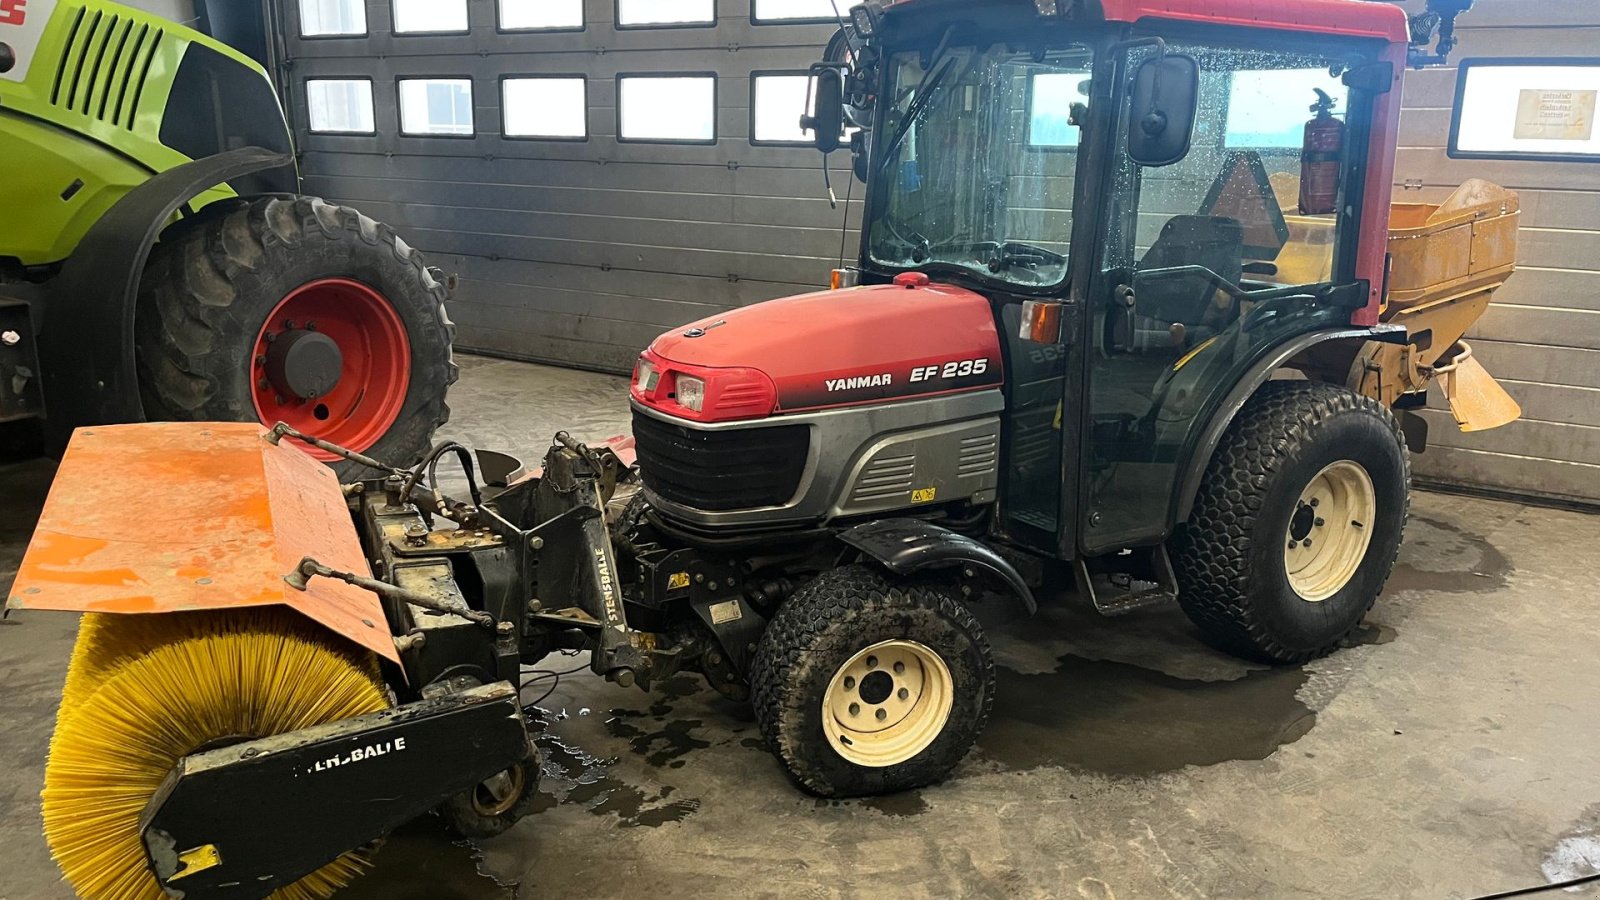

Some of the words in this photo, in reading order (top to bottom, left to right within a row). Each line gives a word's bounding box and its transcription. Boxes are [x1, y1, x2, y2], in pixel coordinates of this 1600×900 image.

[825, 374, 892, 391] YANMAR
[909, 366, 938, 382] EF
[942, 359, 988, 378] 235
